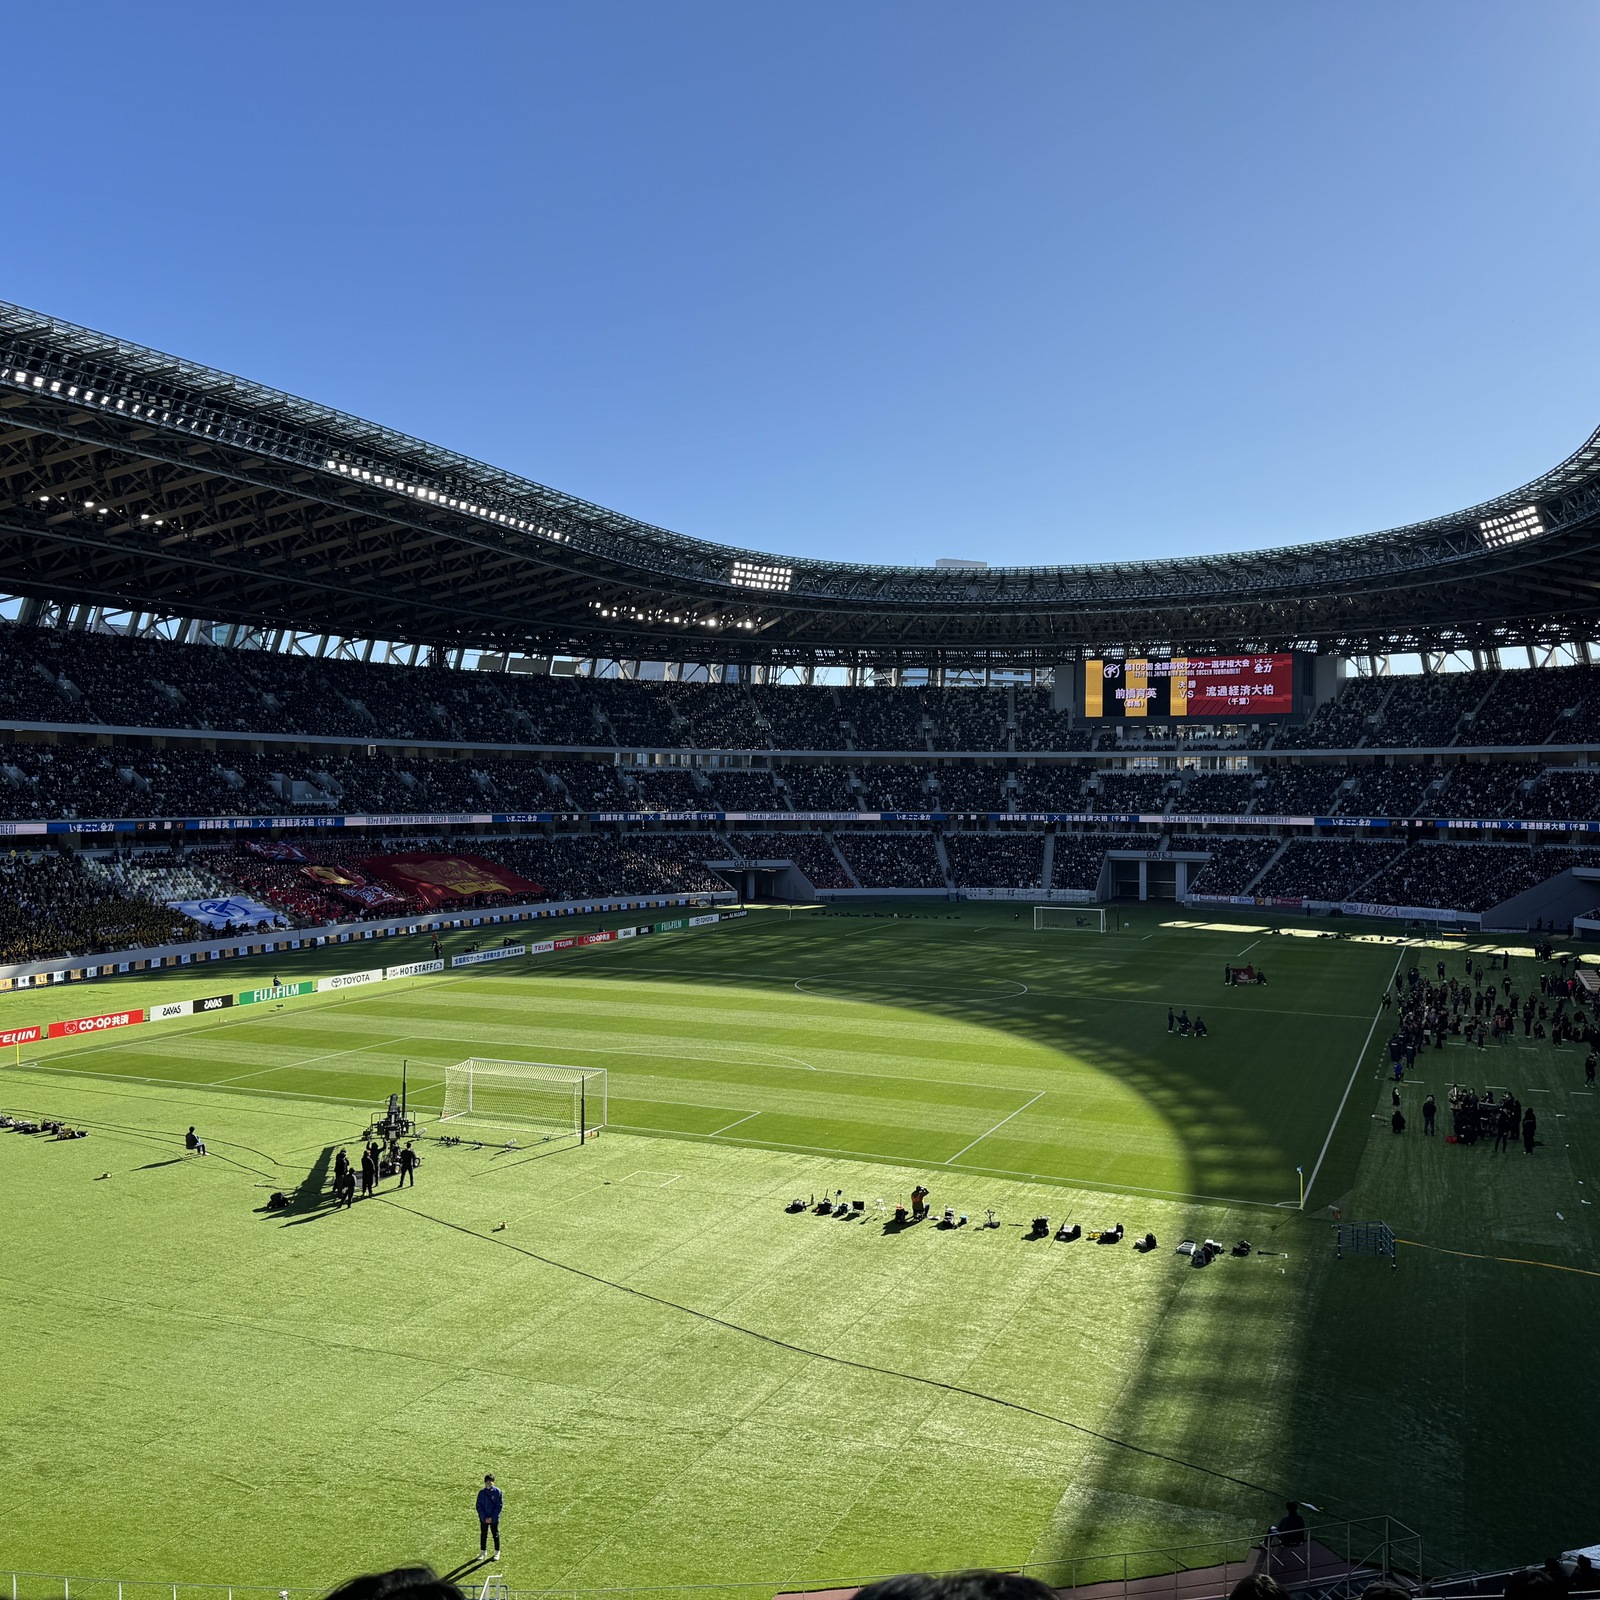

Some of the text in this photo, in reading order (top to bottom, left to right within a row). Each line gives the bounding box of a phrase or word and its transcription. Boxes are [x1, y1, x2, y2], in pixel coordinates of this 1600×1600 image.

[1254, 663, 1272, 673] 全力
[1180, 690, 1194, 699] VS
[1206, 684, 1274, 697] 流通経済大柏
[1360, 904, 1399, 916] FORZA
[534, 943, 552, 951] TEIJIN
[556, 940, 574, 948] TEIJIN
[400, 962, 434, 976] HOT STAFF
[343, 974, 370, 985] TOYOTA
[254, 984, 299, 1002] FUJIFILM
